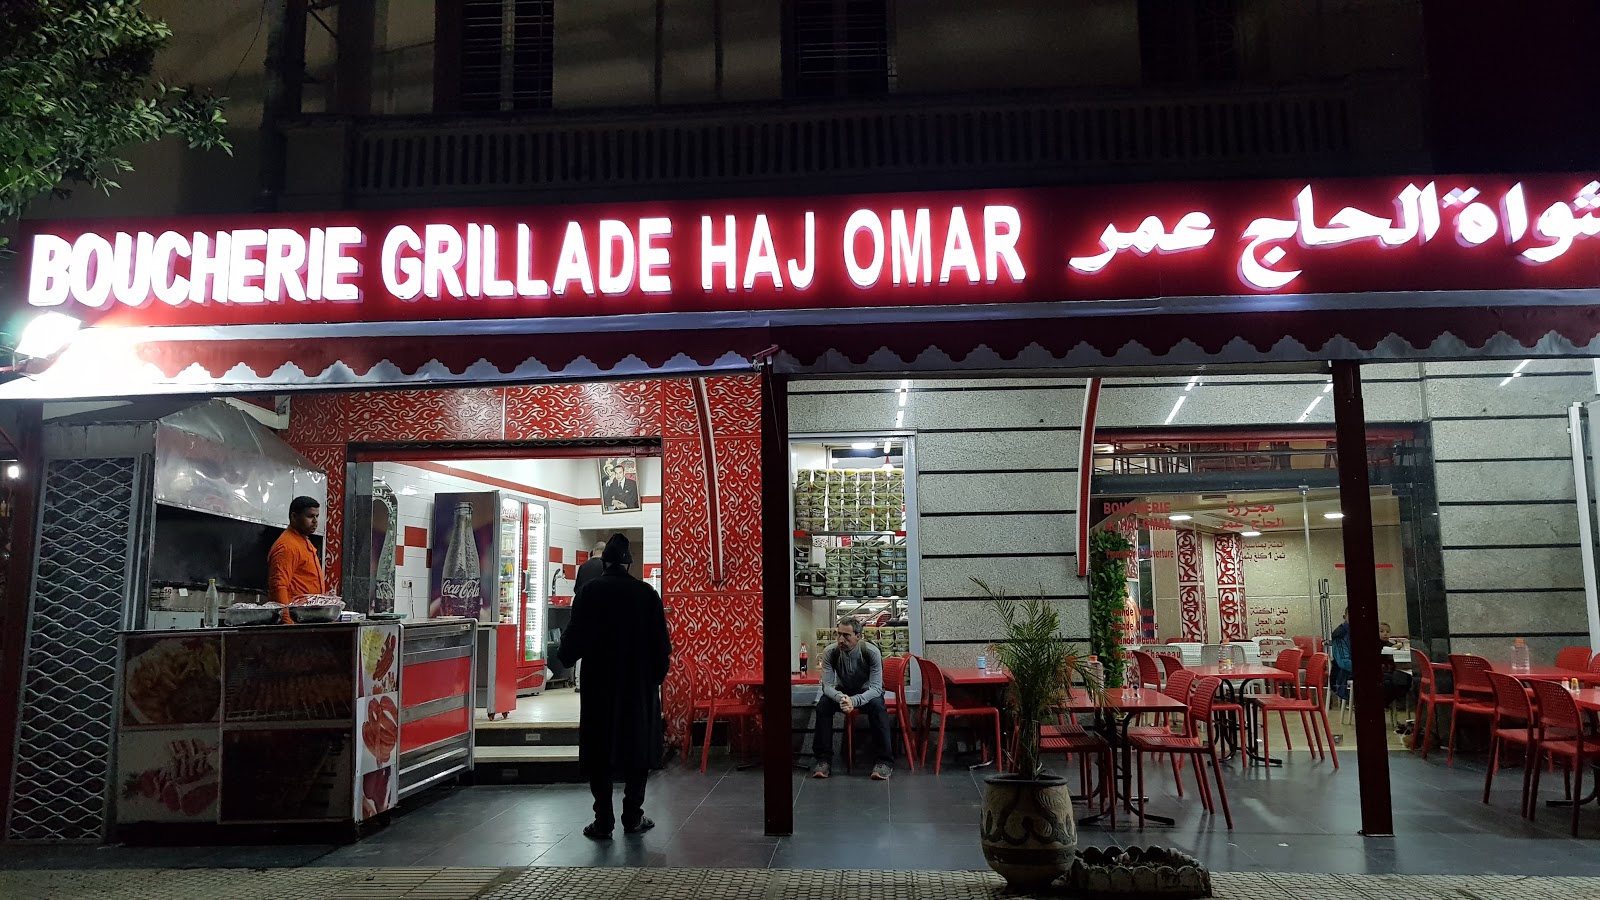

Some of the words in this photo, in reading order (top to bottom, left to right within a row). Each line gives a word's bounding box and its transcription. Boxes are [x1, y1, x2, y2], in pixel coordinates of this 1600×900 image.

[1068, 210, 1216, 275] عمر
[1239, 181, 1440, 289] الحاج
[28, 226, 365, 308] BOUCHERIE
[381, 217, 673, 299] GRILLADE
[701, 211, 816, 291] HAJ
[844, 205, 1027, 287] OMAR
[1227, 500, 1275, 517] مجزرة
[1219, 519, 1243, 532] عمر
[1252, 517, 1285, 531] الحاج
[442, 579, 480, 598] Coca-Cola
